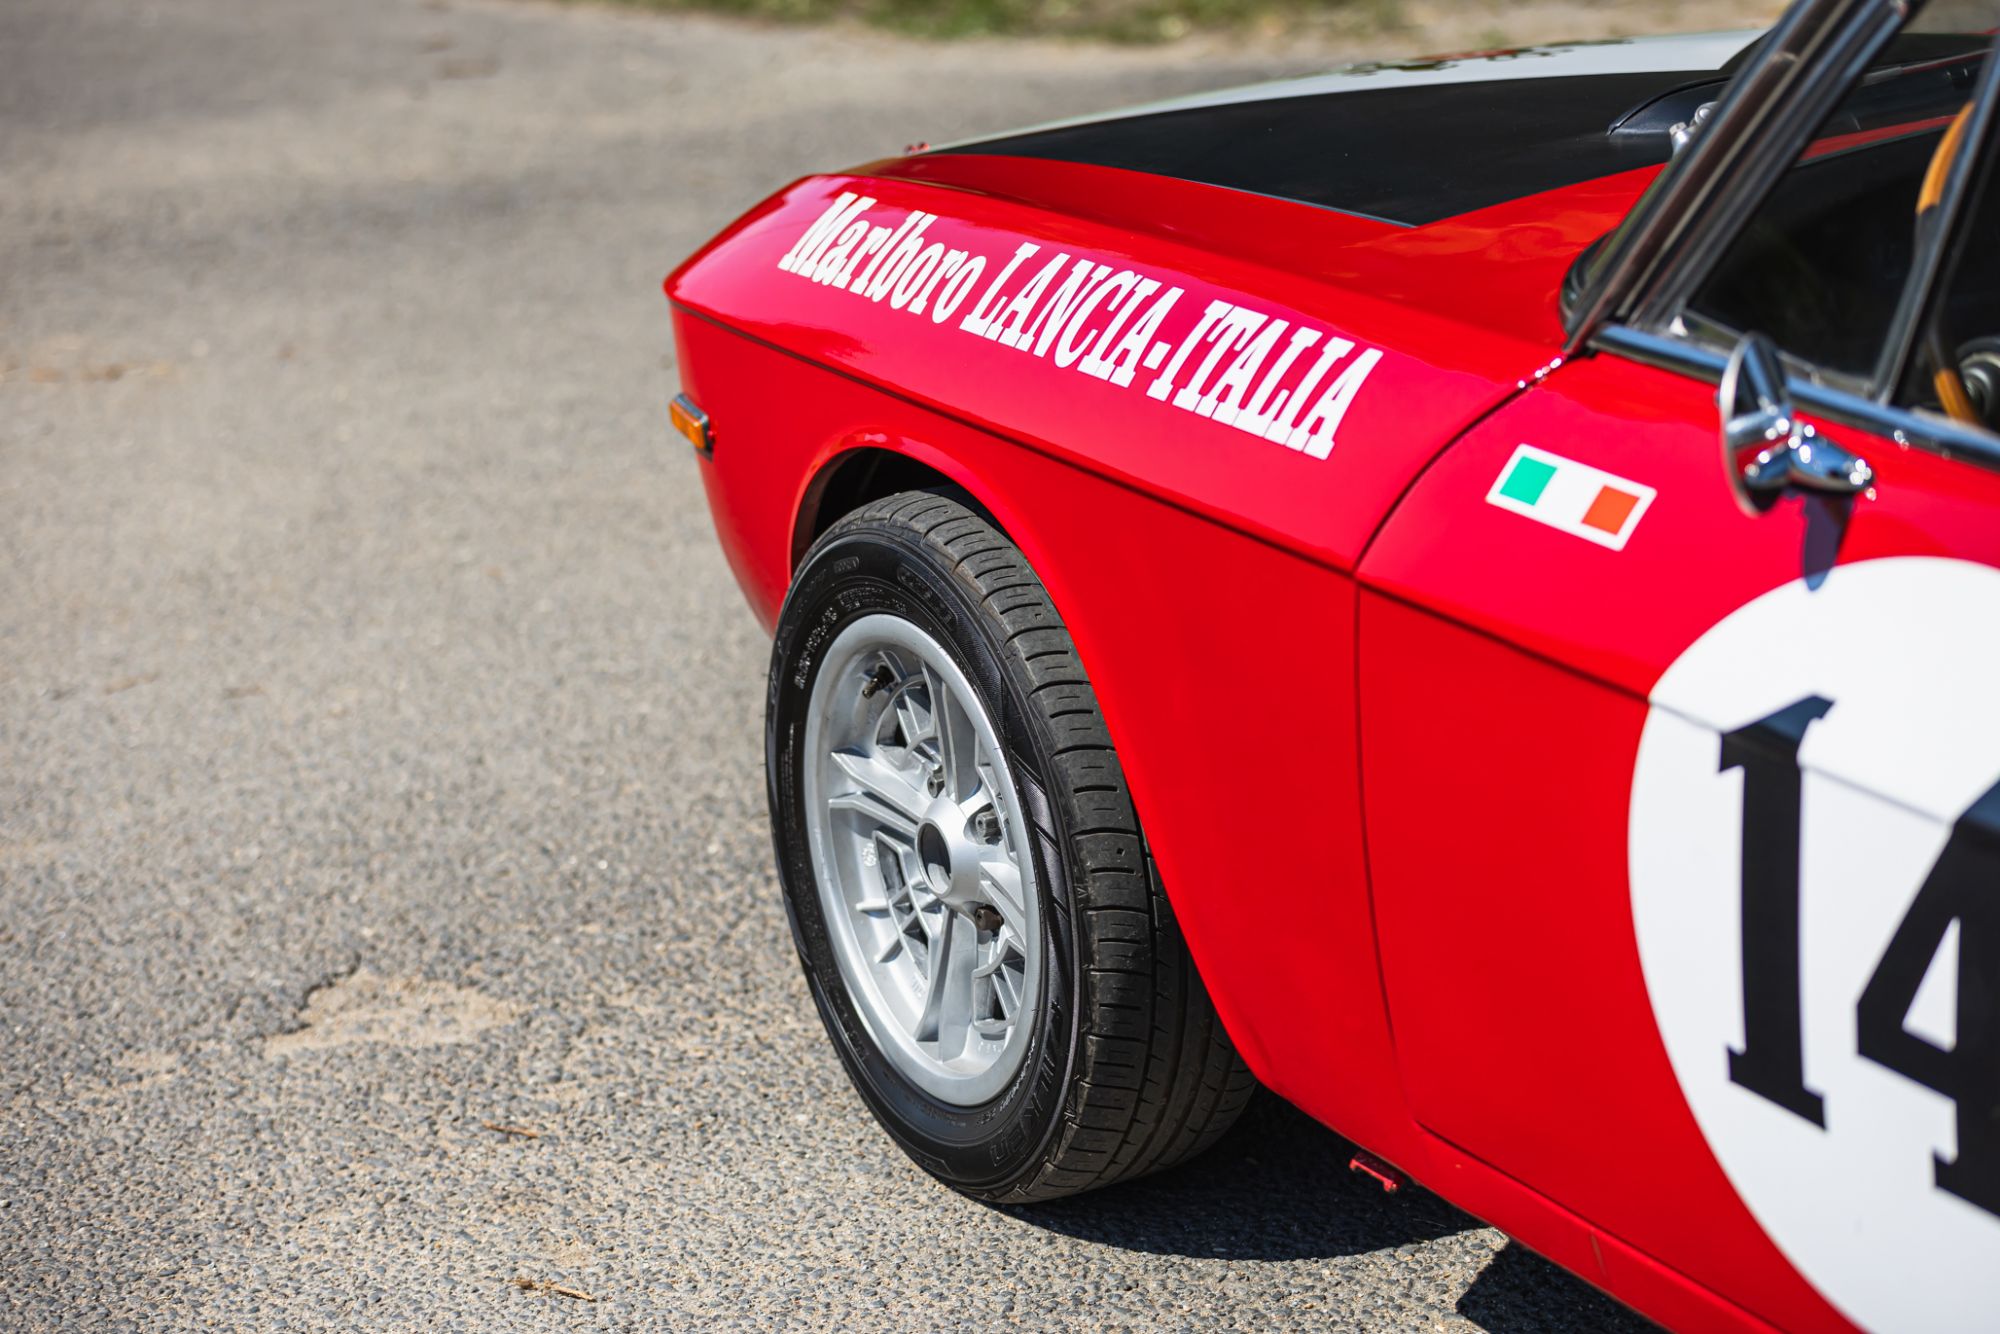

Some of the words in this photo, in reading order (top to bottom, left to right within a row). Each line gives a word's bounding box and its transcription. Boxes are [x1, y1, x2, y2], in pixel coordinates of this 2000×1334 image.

[777, 192, 986, 324] Marlboro
[959, 242, 1384, 461] LANCIA-ITALIA
[1718, 694, 2000, 1222] 14
